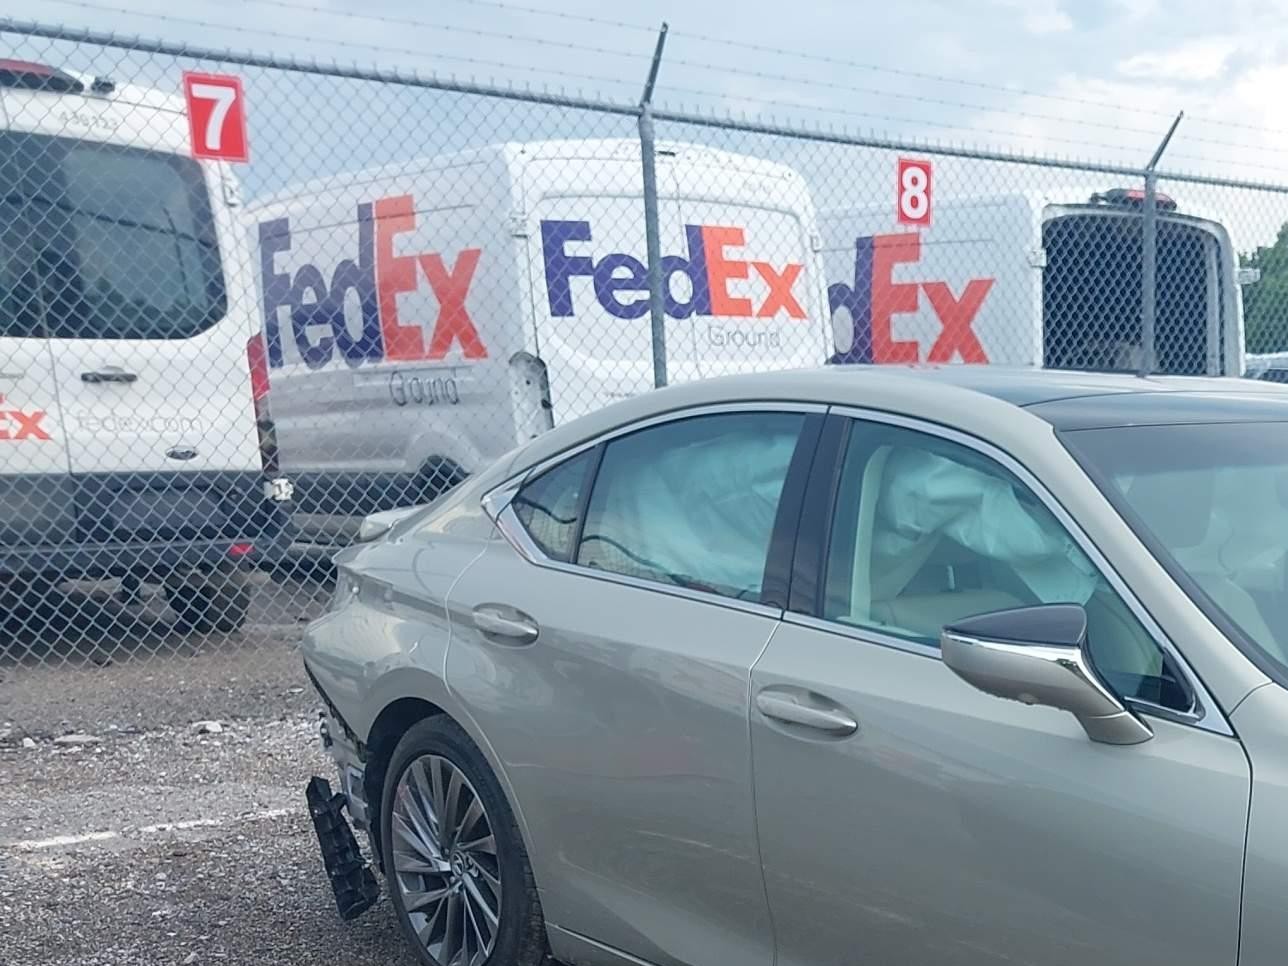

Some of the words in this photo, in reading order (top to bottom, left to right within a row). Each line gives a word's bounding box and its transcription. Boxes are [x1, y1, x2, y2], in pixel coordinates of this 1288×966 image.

[191, 83, 238, 150] 7
[901, 166, 928, 219] 8
[258, 194, 488, 369] FedEx
[540, 219, 807, 319] FedEx
[707, 326, 781, 347] Ground
